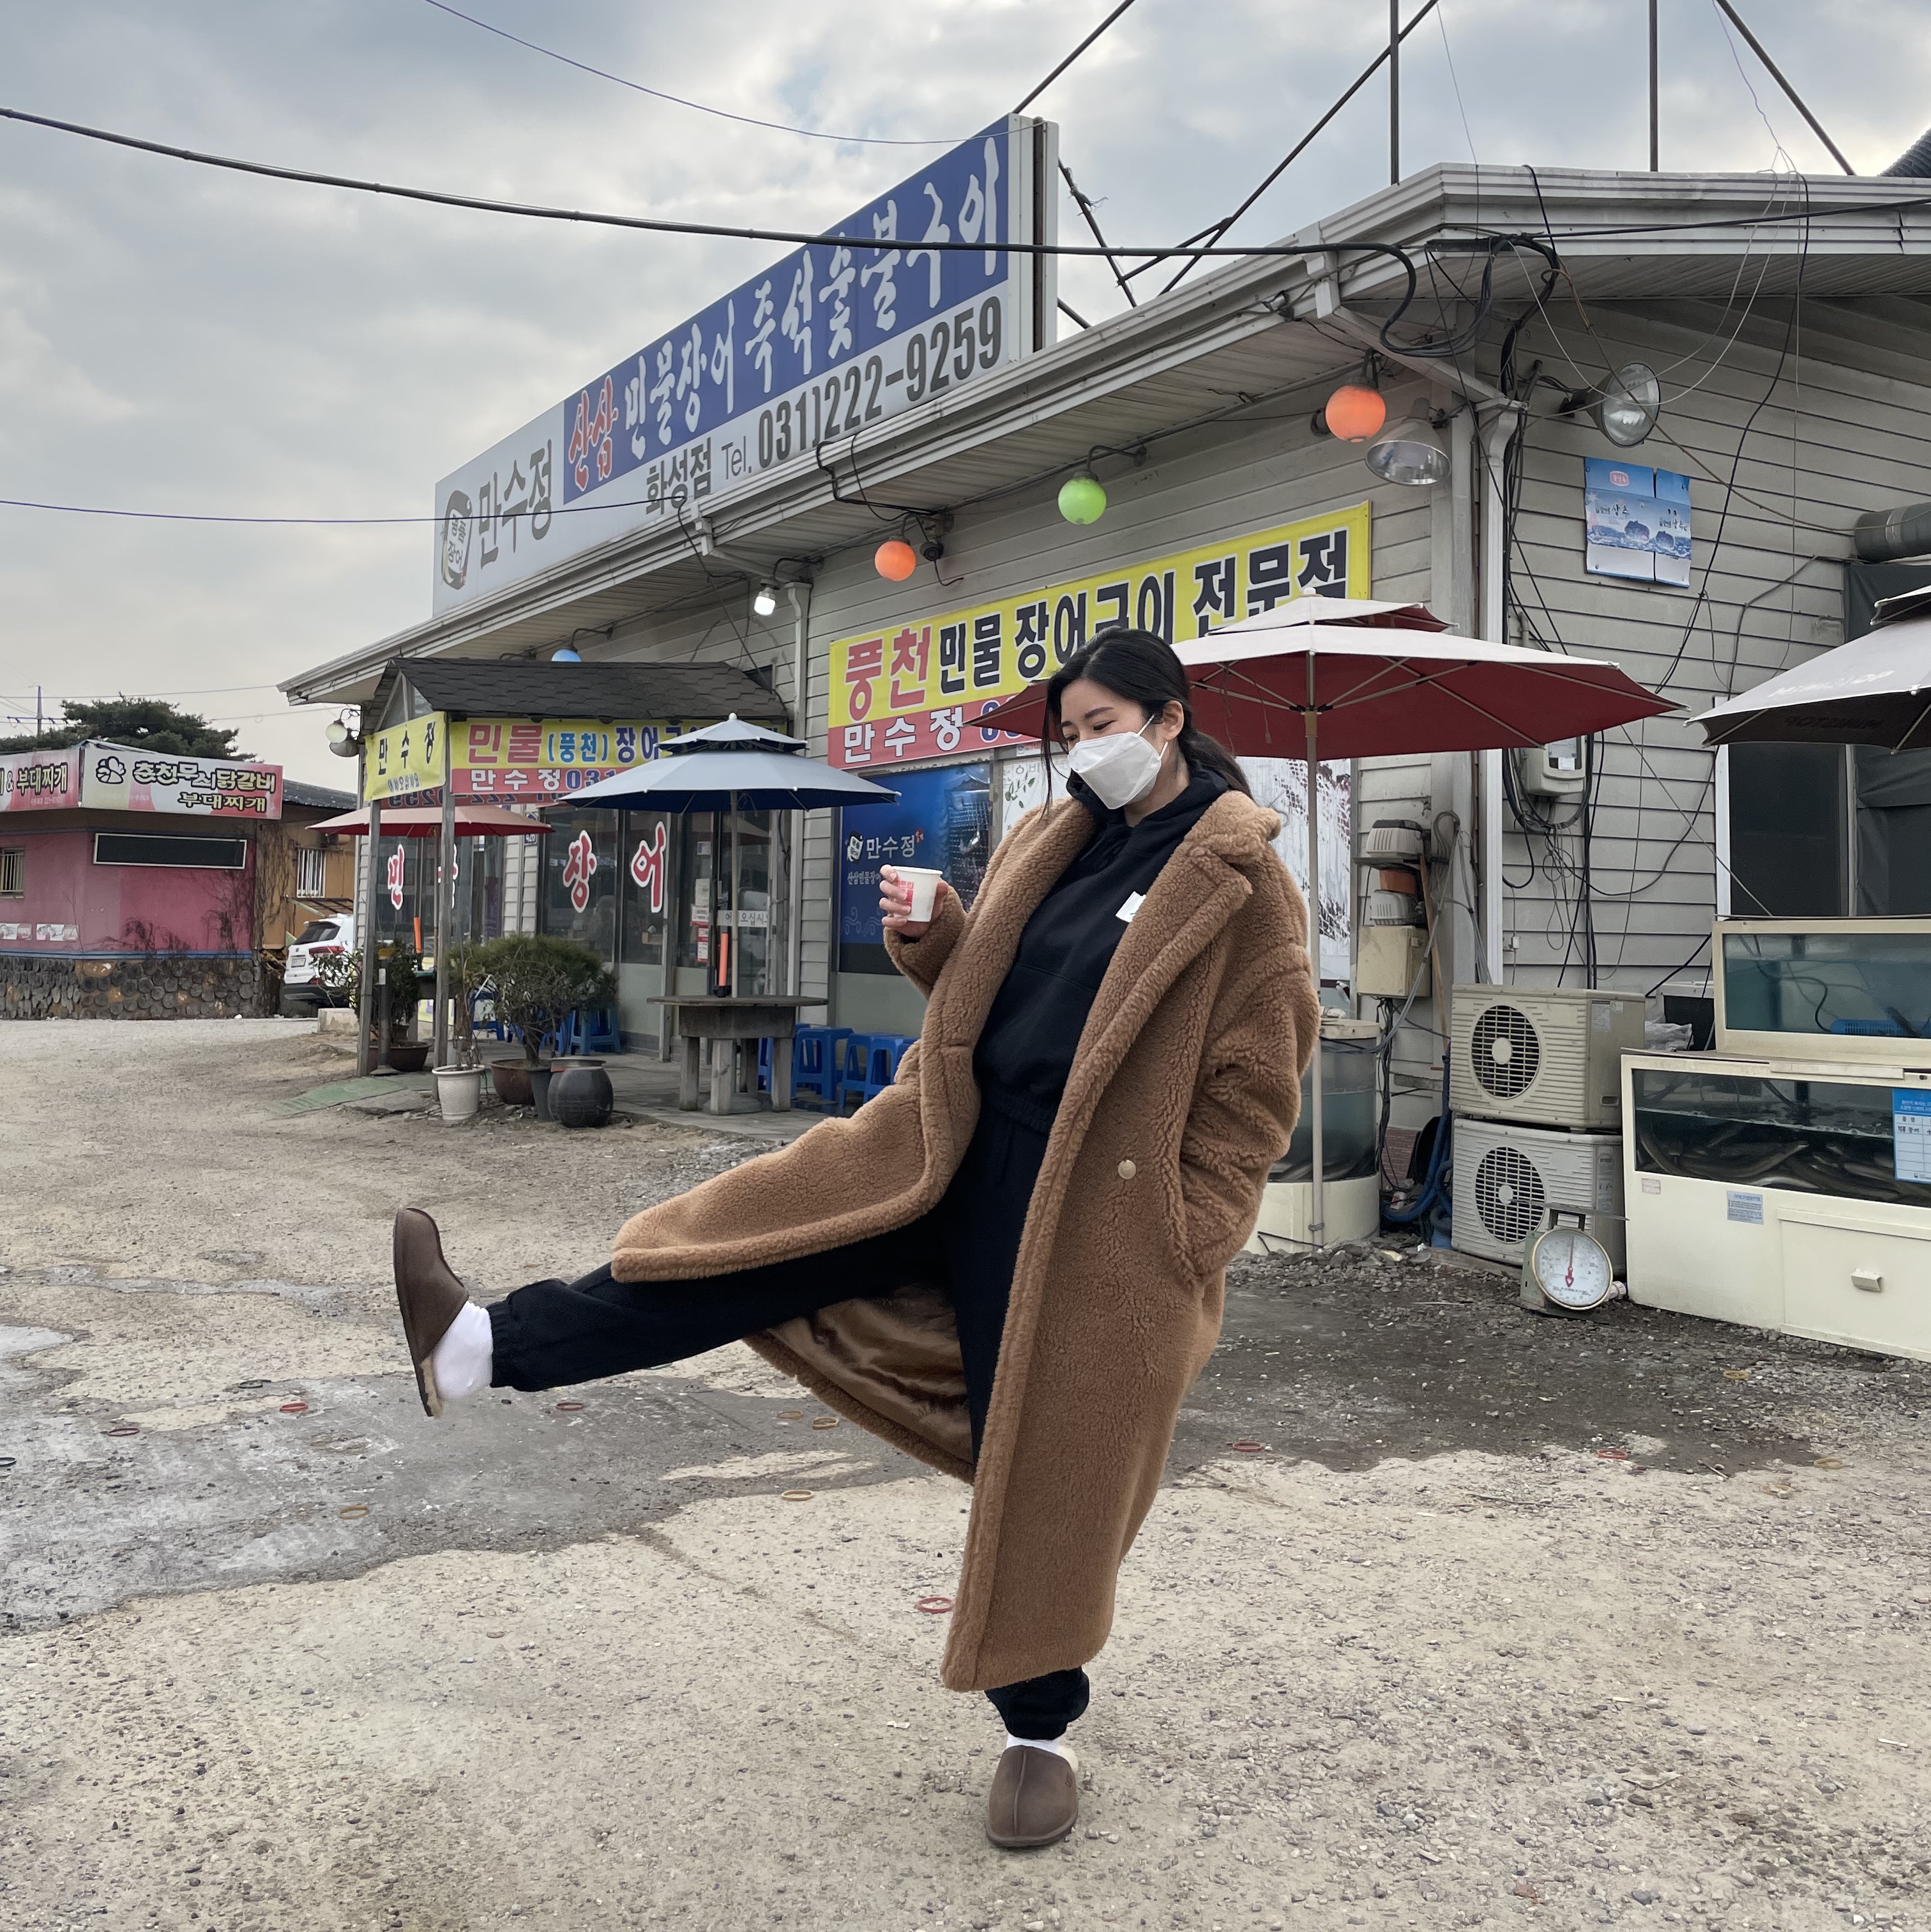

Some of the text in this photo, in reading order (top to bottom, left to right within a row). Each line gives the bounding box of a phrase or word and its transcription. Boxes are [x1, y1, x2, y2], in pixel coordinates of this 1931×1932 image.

[722, 296, 1001, 479] Tel. 031)222-9259
[568, 375, 618, 492] 산삼
[479, 439, 552, 570] 만수정
[646, 437, 712, 515] 화성점
[845, 625, 930, 721] 풍천
[844, 706, 962, 764] 만수정
[17, 762, 68, 796] 부대찌개
[178, 792, 267, 812] 부대찌개
[471, 769, 560, 791] 만수정
[867, 835, 915, 860] 만수정
